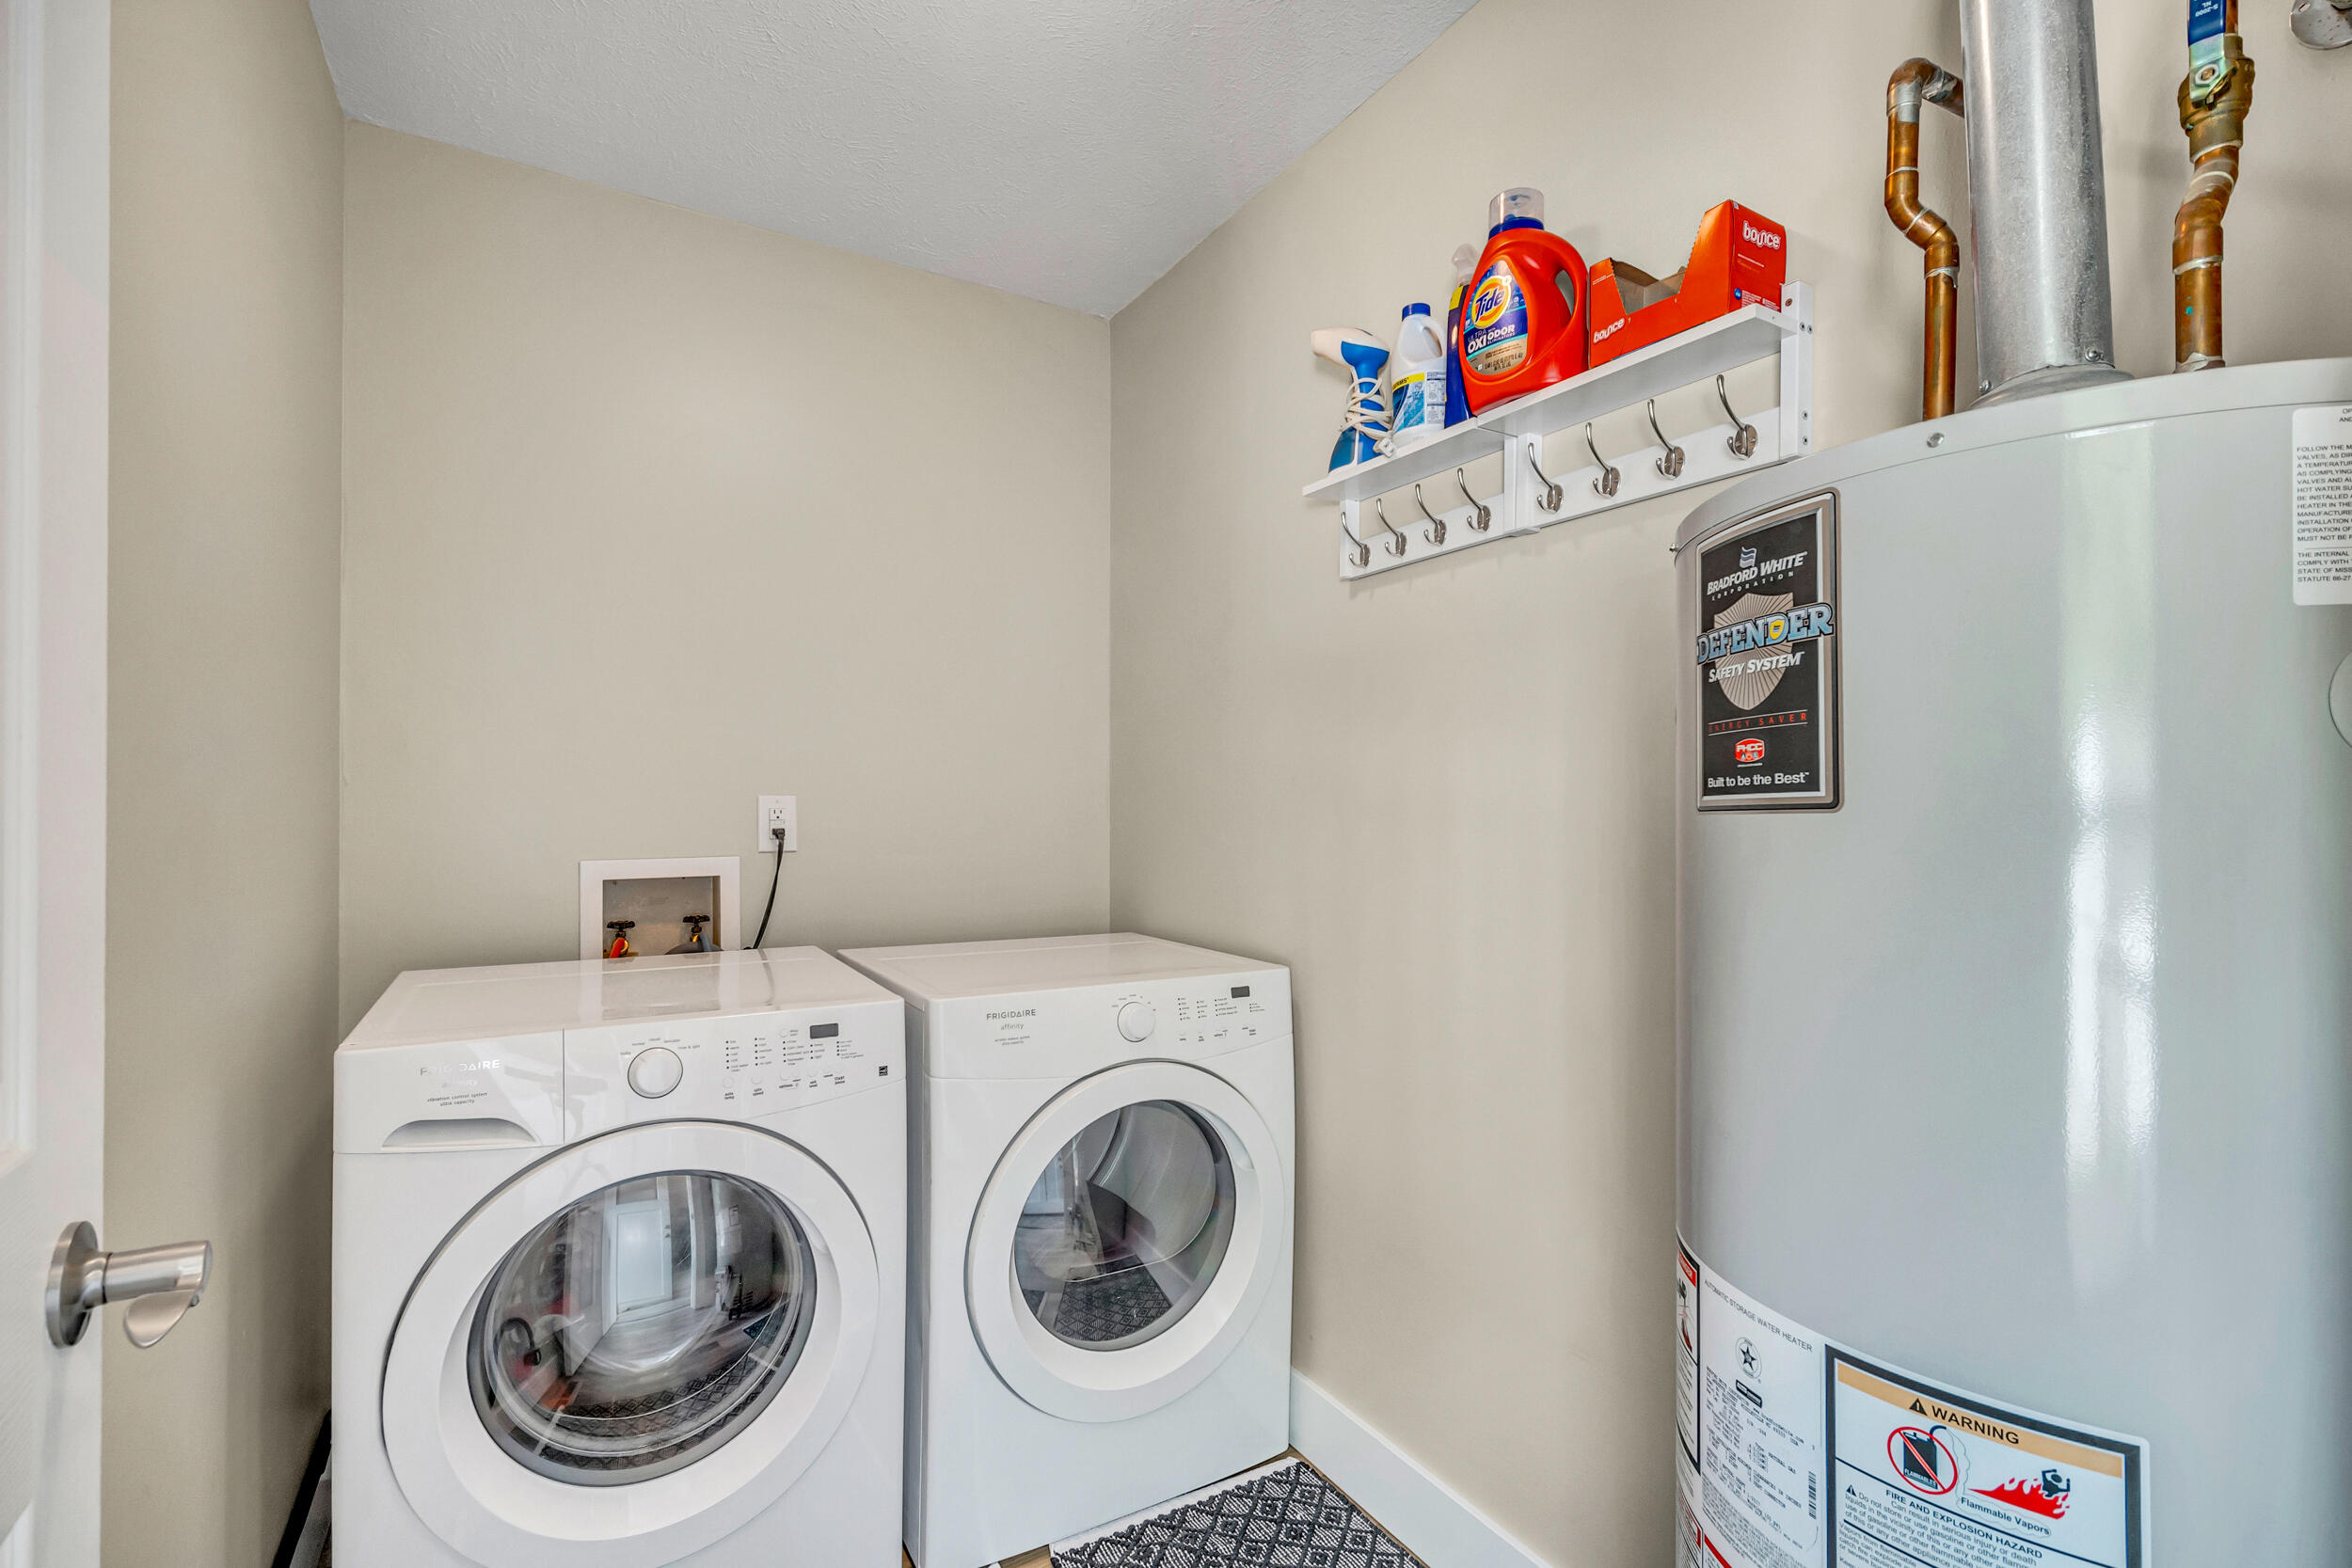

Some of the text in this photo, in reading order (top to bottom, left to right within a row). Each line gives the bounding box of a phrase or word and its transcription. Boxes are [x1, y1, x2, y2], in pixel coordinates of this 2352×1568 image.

[1742, 219, 1782, 250] bounce
[1475, 285, 1505, 324] Tide
[1468, 334, 1486, 355] OXI
[1487, 325, 1516, 341] ODOR
[1593, 317, 1626, 344] bounce
[1707, 552, 1805, 595] BRADFORD WHITE
[1712, 571, 1794, 601] CORPORATION
[1697, 603, 1835, 665] DEFENDER
[1708, 652, 1803, 683] SAFETY SYSTEM
[1708, 712, 1806, 734] ENERGY SAVER
[1708, 776, 1725, 788] Built
[1725, 776, 1736, 787] to
[1738, 775, 1751, 786] be
[1753, 773, 1772, 785] the
[986, 1009, 1036, 1021] FRIGIDAIRE
[1705, 1279, 1813, 1353] AUTOMATIC STORAGE WATER HEATER
[1931, 1405, 2019, 1445] WARNING
[1845, 1494, 1994, 1568] liquids in the vicinity of this or any other
[1858, 1492, 1869, 1503] Do
[1870, 1499, 1882, 1509] not
[1883, 1505, 1902, 1518] store
[1914, 1520, 1928, 1531] use
[1931, 1526, 1964, 1547] gasoline
[1966, 1541, 1975, 1551] or
[1978, 1545, 1999, 1561] other
[1885, 1489, 2042, 1559] FIRE AND EXPLOSION HAZARD
[1891, 1500, 2037, 1566] Can result in serious injury or death
[1961, 1497, 2050, 1535] Flammable Vapors
[1845, 1503, 1974, 1568] use of gasoline or other flammable
[1845, 1510, 1853, 1518] of
[1853, 1513, 1866, 1526] this
[1876, 1526, 1889, 1540] any
[1891, 1534, 1912, 1549] other
[1913, 1544, 1950, 1568] appliance
[1874, 1548, 1902, 1567] explode
[1880, 1543, 1917, 1567] flammable
